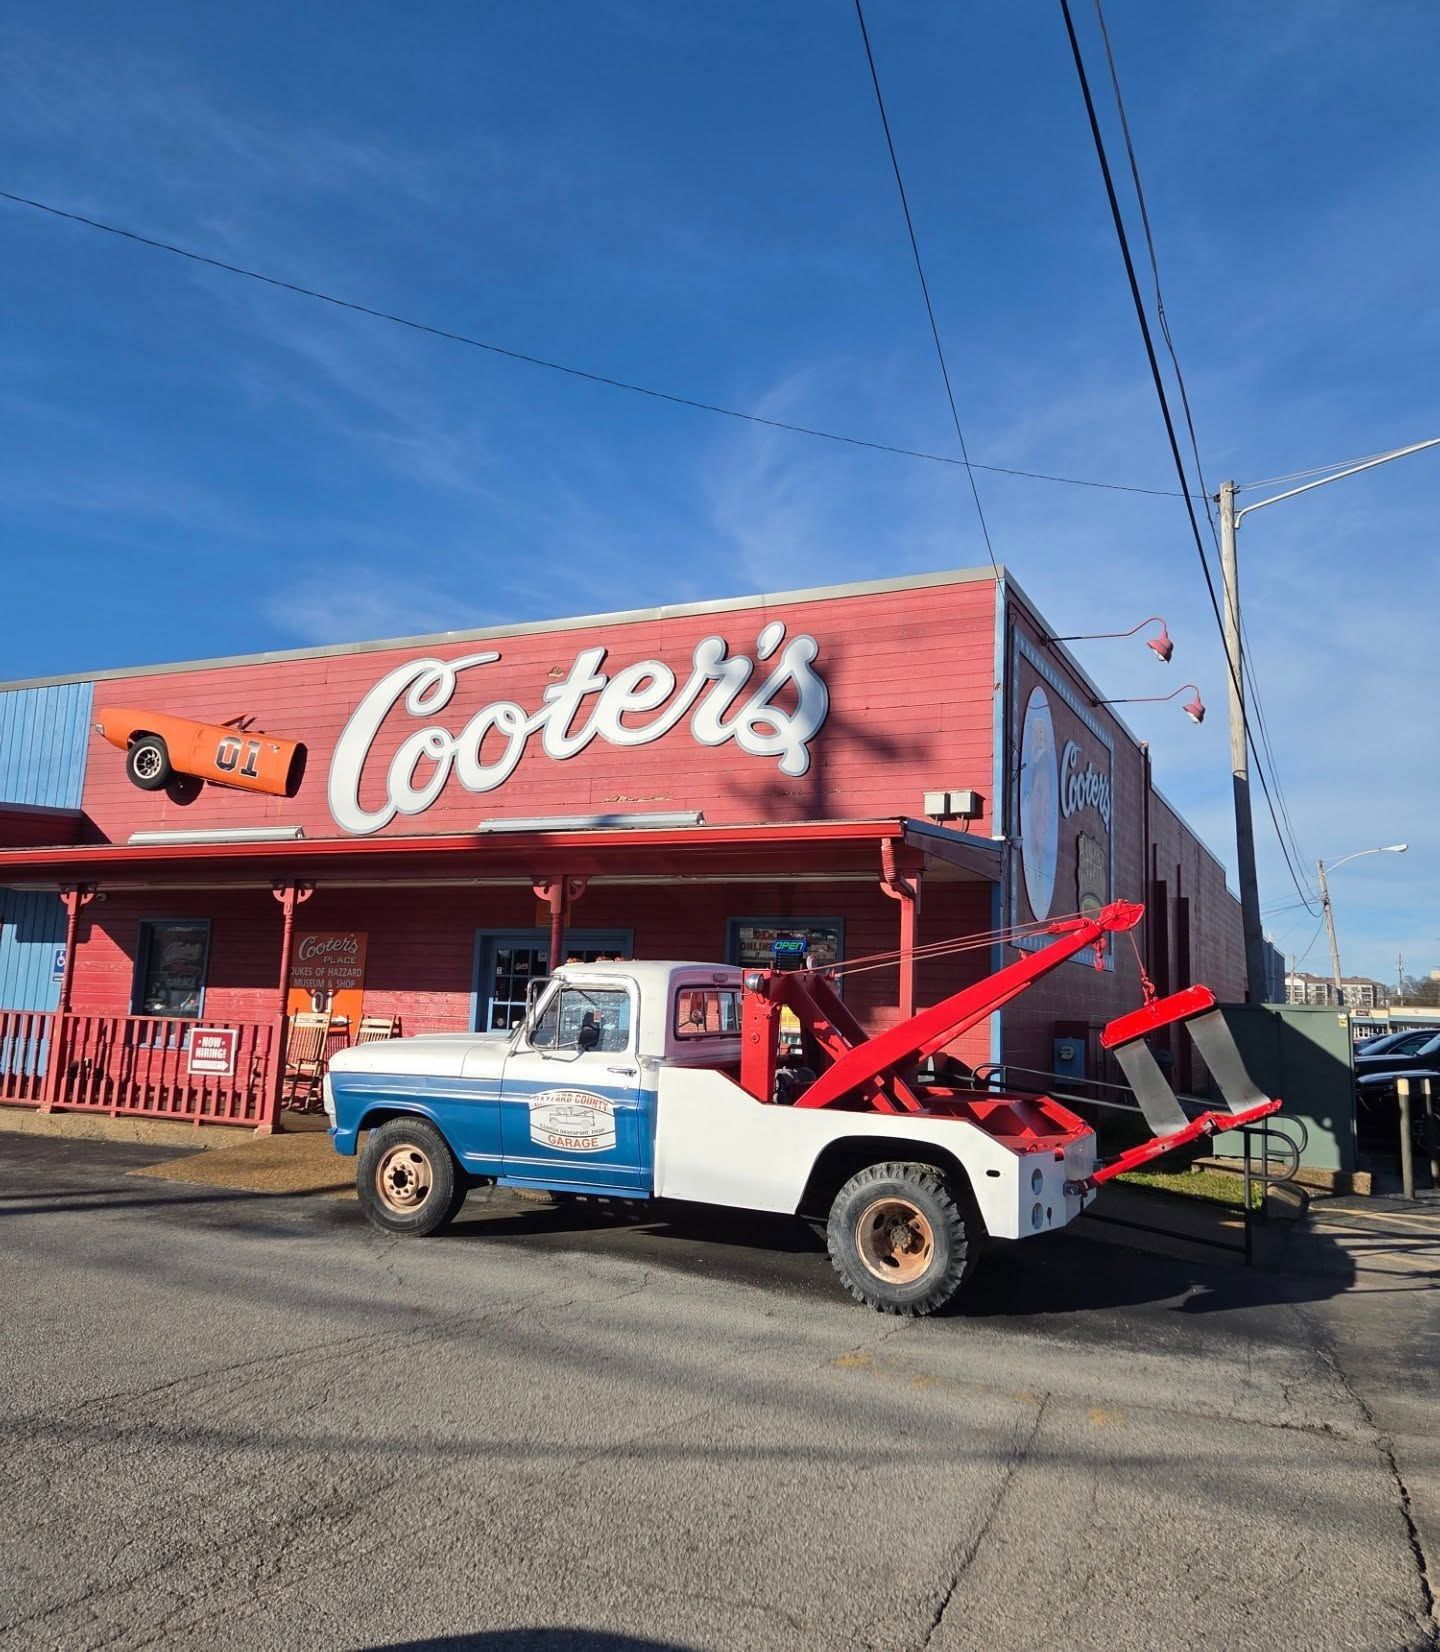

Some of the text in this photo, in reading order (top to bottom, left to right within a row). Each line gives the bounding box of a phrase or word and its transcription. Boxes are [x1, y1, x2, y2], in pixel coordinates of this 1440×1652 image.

[328, 620, 829, 836] Cooter's
[216, 735, 260, 779] 01
[774, 941, 804, 950] OPEN
[323, 956, 357, 964] PLACE
[315, 967, 325, 976] OF
[328, 968, 363, 977] HAZZARD
[294, 978, 325, 988] MUSEUM
[336, 980, 356, 988] SHOP
[202, 1036, 222, 1047] NOW
[195, 1047, 227, 1058] HIRING!
[574, 1094, 609, 1112] COUNTY
[547, 1134, 600, 1148] GARAGE
